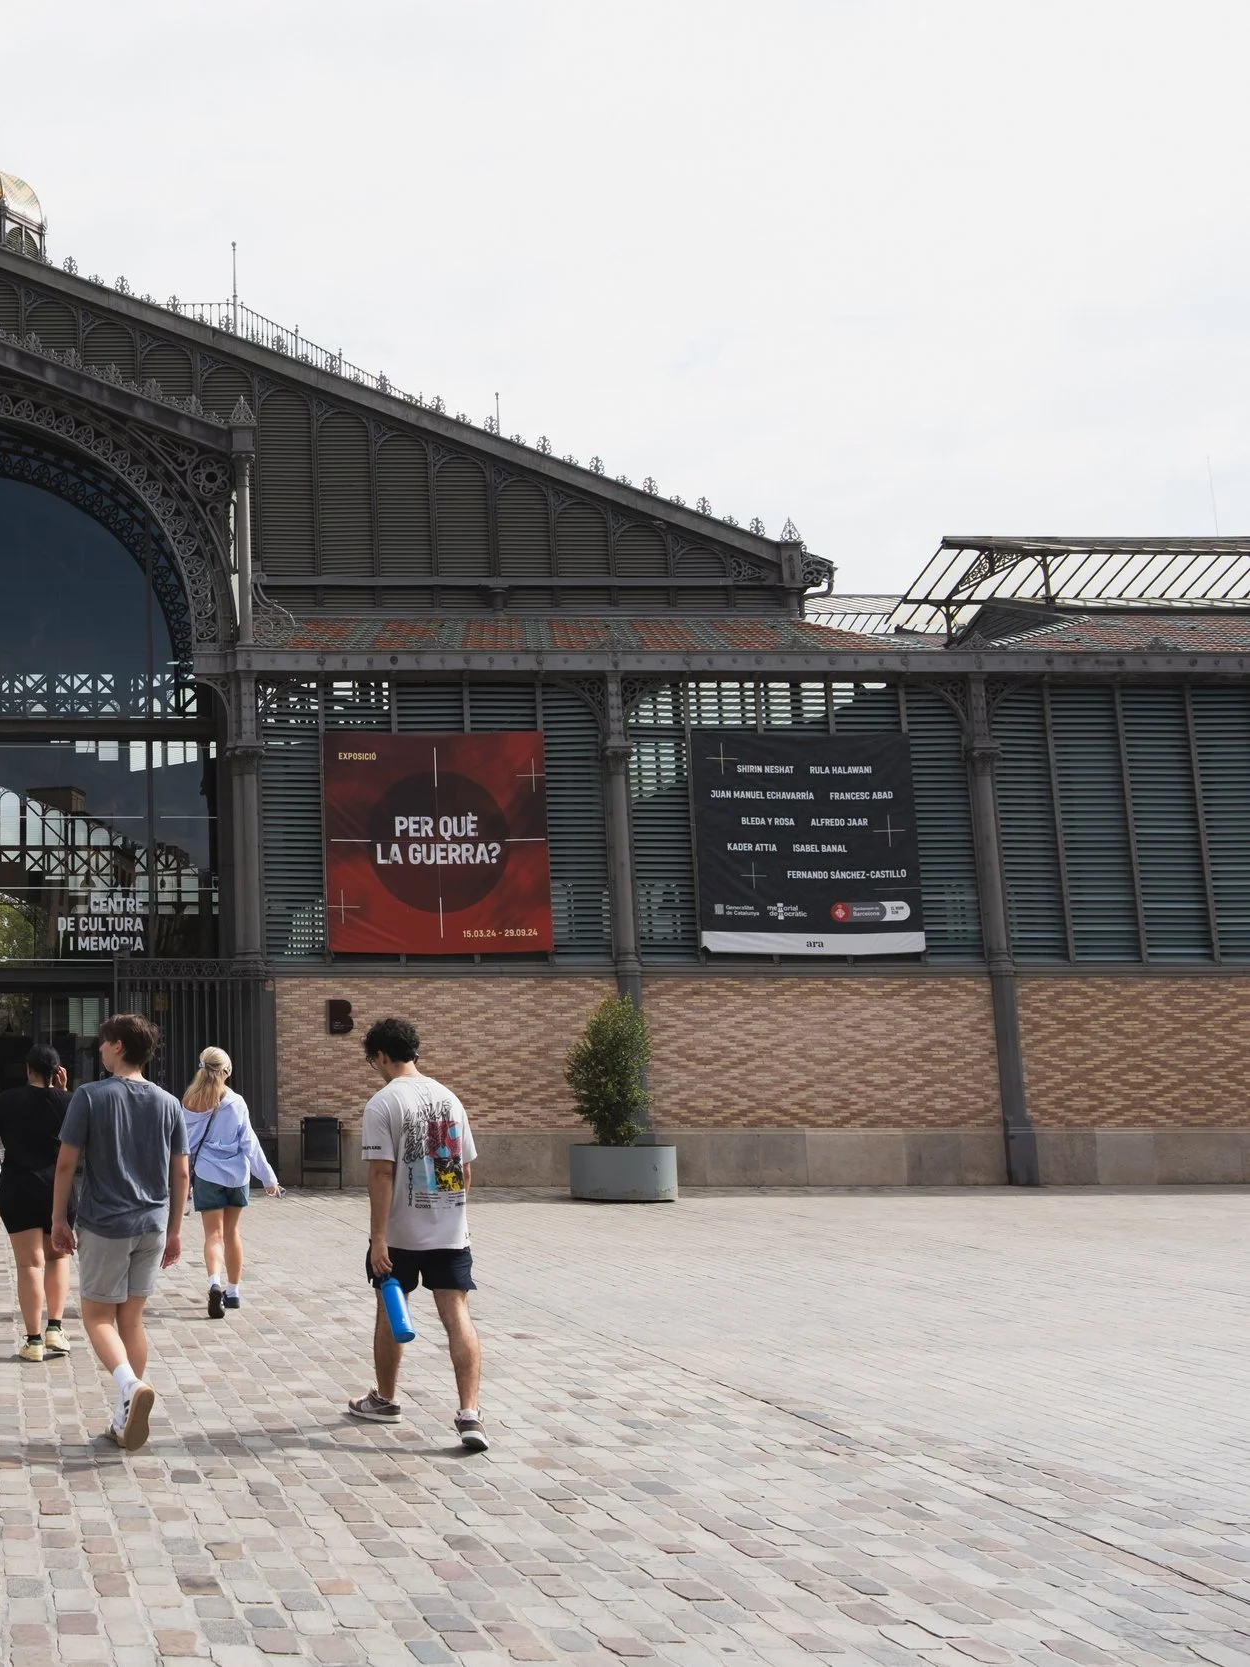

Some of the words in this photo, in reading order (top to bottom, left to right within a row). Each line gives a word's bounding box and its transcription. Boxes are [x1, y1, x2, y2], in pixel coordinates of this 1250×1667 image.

[338, 752, 377, 760] EXPOSICIÓ
[736, 764, 763, 773] SHIRIN
[764, 765, 794, 774] NESHAT
[810, 766, 830, 774] RULA
[831, 766, 872, 774] HALAWANI
[710, 790, 732, 798] JUAN
[733, 790, 765, 799] MANUEL
[766, 790, 815, 800] ECHAVARRÍA
[830, 791, 870, 800] FRANCESC
[872, 791, 893, 800] ABAD
[741, 816, 766, 825] BLEDA
[767, 817, 772, 826] Y
[774, 817, 795, 826] ROSA
[810, 818, 845, 826] ALFREDO
[846, 818, 868, 826] JAAR
[394, 816, 434, 837] PER
[439, 812, 479, 841] QUÈ
[727, 842, 753, 851] KADER
[755, 843, 777, 852] ATTIA
[792, 844, 820, 852] ISABEL
[821, 844, 848, 852] BANAL
[376, 843, 403, 864] LA
[408, 842, 501, 865] GUERRA?
[787, 870, 829, 879] FERNANDO
[830, 869, 907, 879] SÁNCHEZ-CASTILLO
[90, 898, 144, 912] CENTRE
[57, 917, 76, 931] DE
[79, 917, 144, 931] CULTURA
[462, 929, 497, 938] 15.03.24
[504, 928, 538, 937] 29.09.24
[69, 936, 74, 951] I
